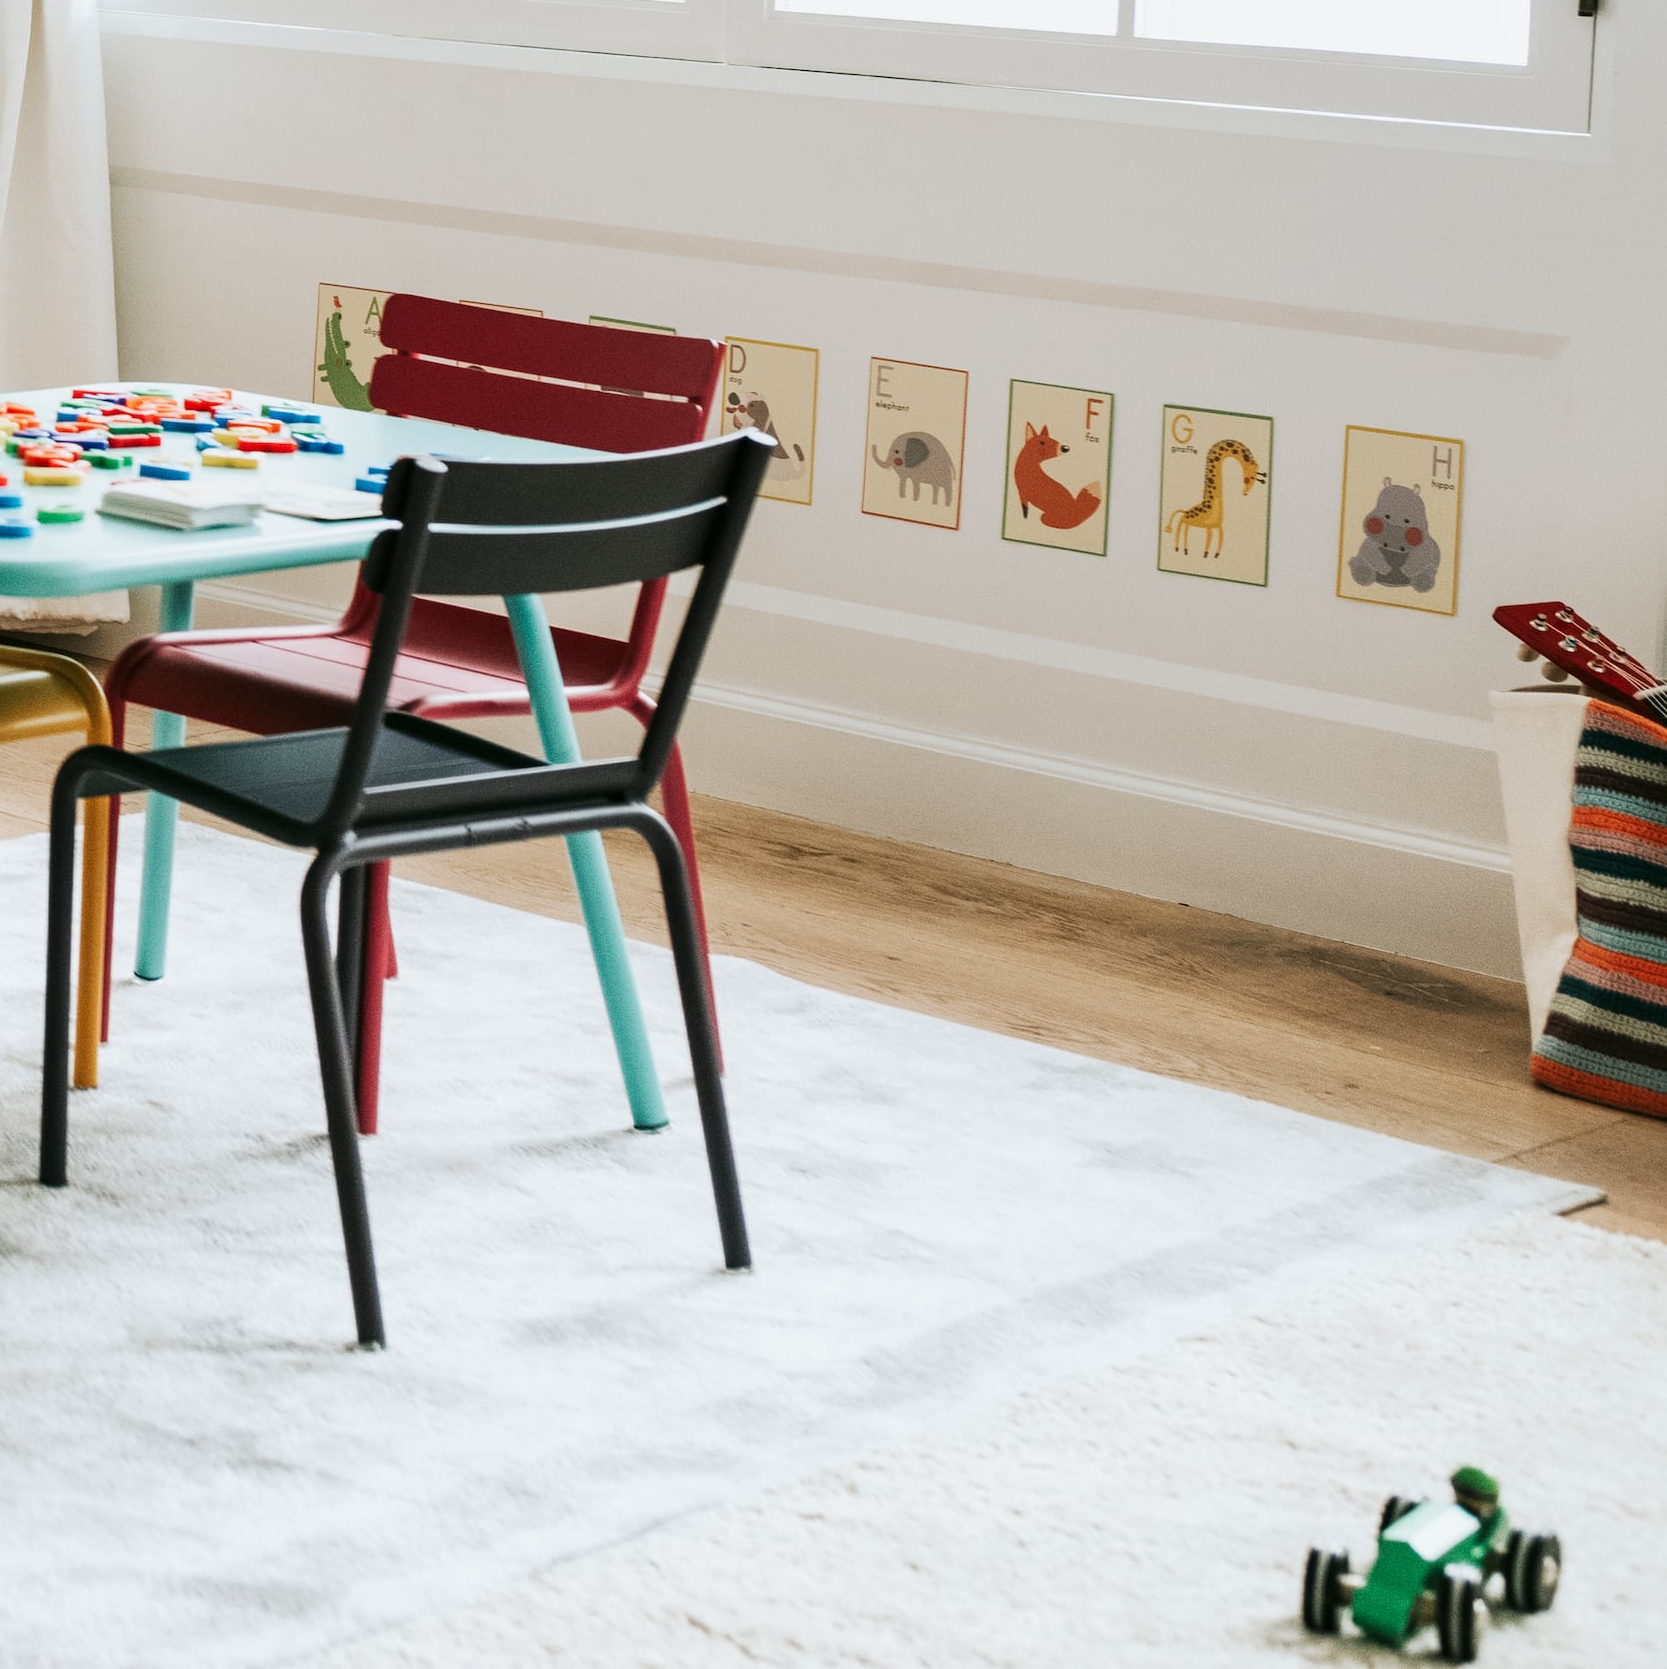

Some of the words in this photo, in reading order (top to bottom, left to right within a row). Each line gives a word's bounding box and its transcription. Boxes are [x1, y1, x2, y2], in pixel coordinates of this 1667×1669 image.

[365, 296, 382, 325] A
[729, 344, 746, 374] D
[876, 365, 894, 398] E
[875, 400, 910, 413] elephant
[1085, 398, 1105, 430] F
[1084, 433, 1100, 444] fox
[1171, 413, 1194, 445] G
[1170, 445, 1198, 456] giraffe
[1432, 444, 1453, 480] H
[1431, 479, 1455, 492] hippo
